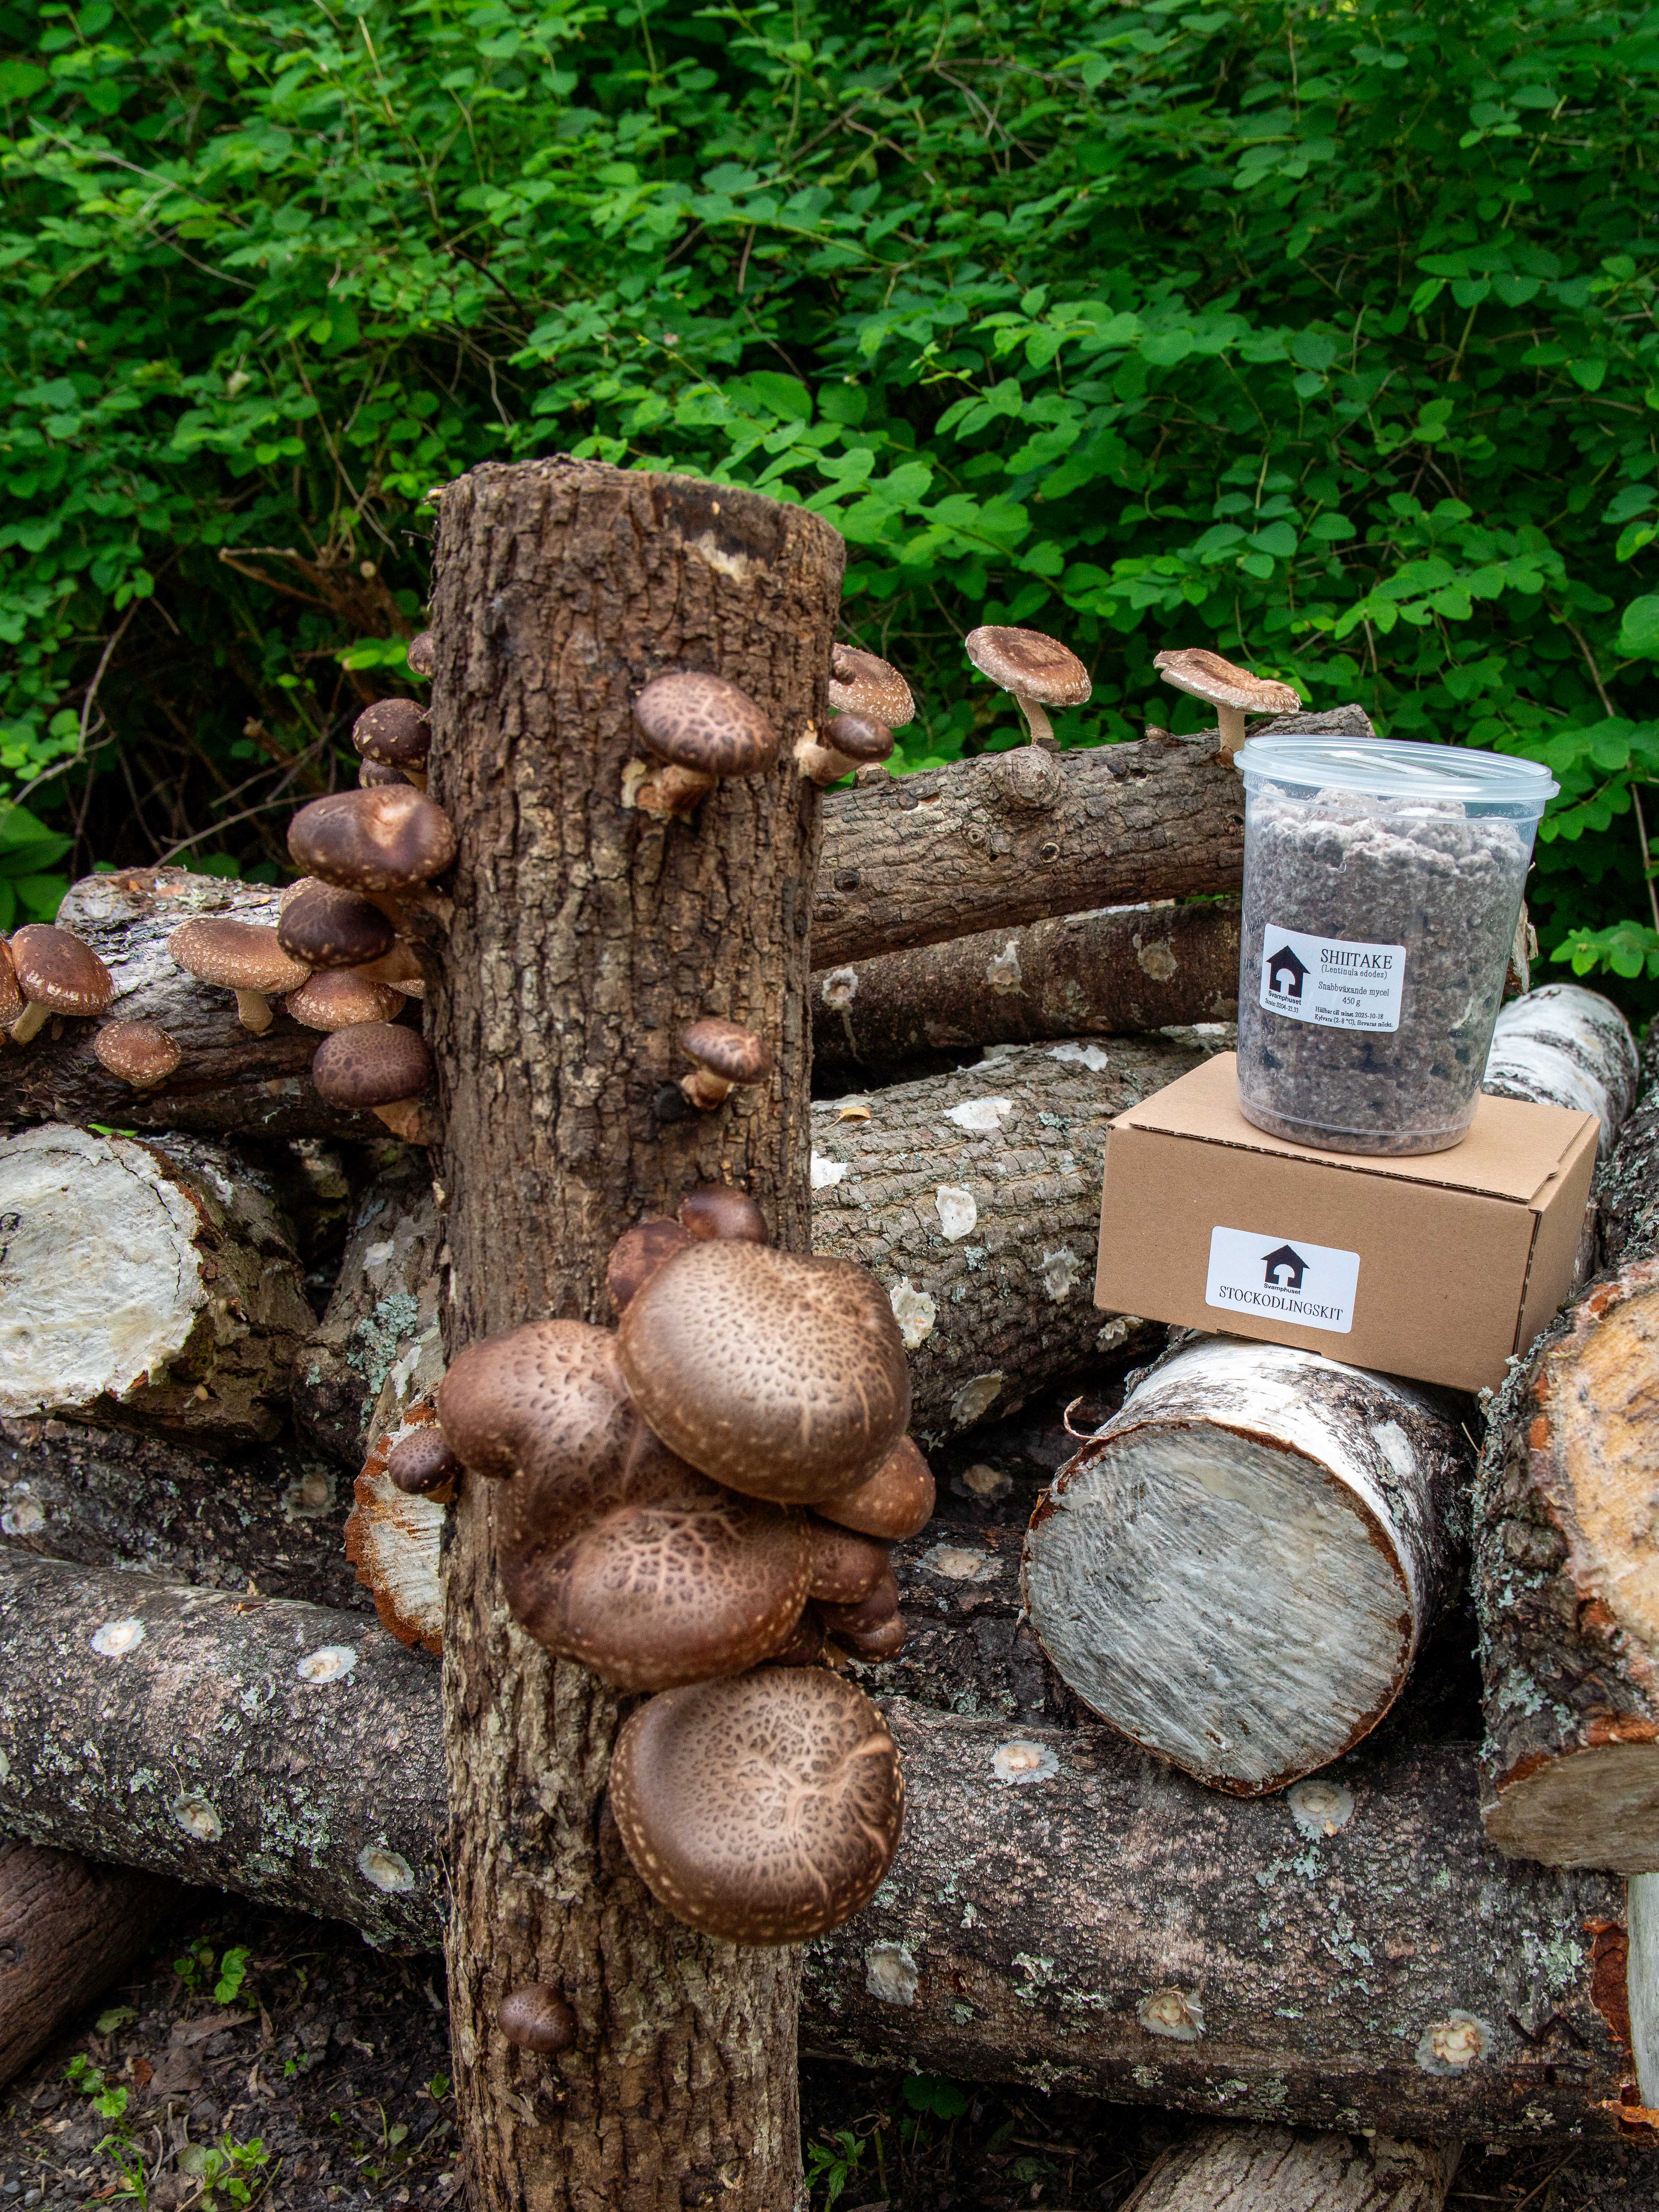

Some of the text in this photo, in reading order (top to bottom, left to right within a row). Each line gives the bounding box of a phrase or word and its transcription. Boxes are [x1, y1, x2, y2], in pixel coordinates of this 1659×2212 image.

[1320, 949, 1392, 969] SHIITAKE
[1322, 964, 1388, 980] (Lentinula edodes)
[1318, 981, 1389, 997] Snabbväxande mycel
[1265, 998, 1276, 1006] Strain:
[1268, 990, 1301, 1005] Svamphuset
[1314, 1014, 1332, 1022] Kylvara
[1264, 1283, 1300, 1295] Svamphuset
[1219, 1286, 1343, 1320] STOCKODLINGSKIT
